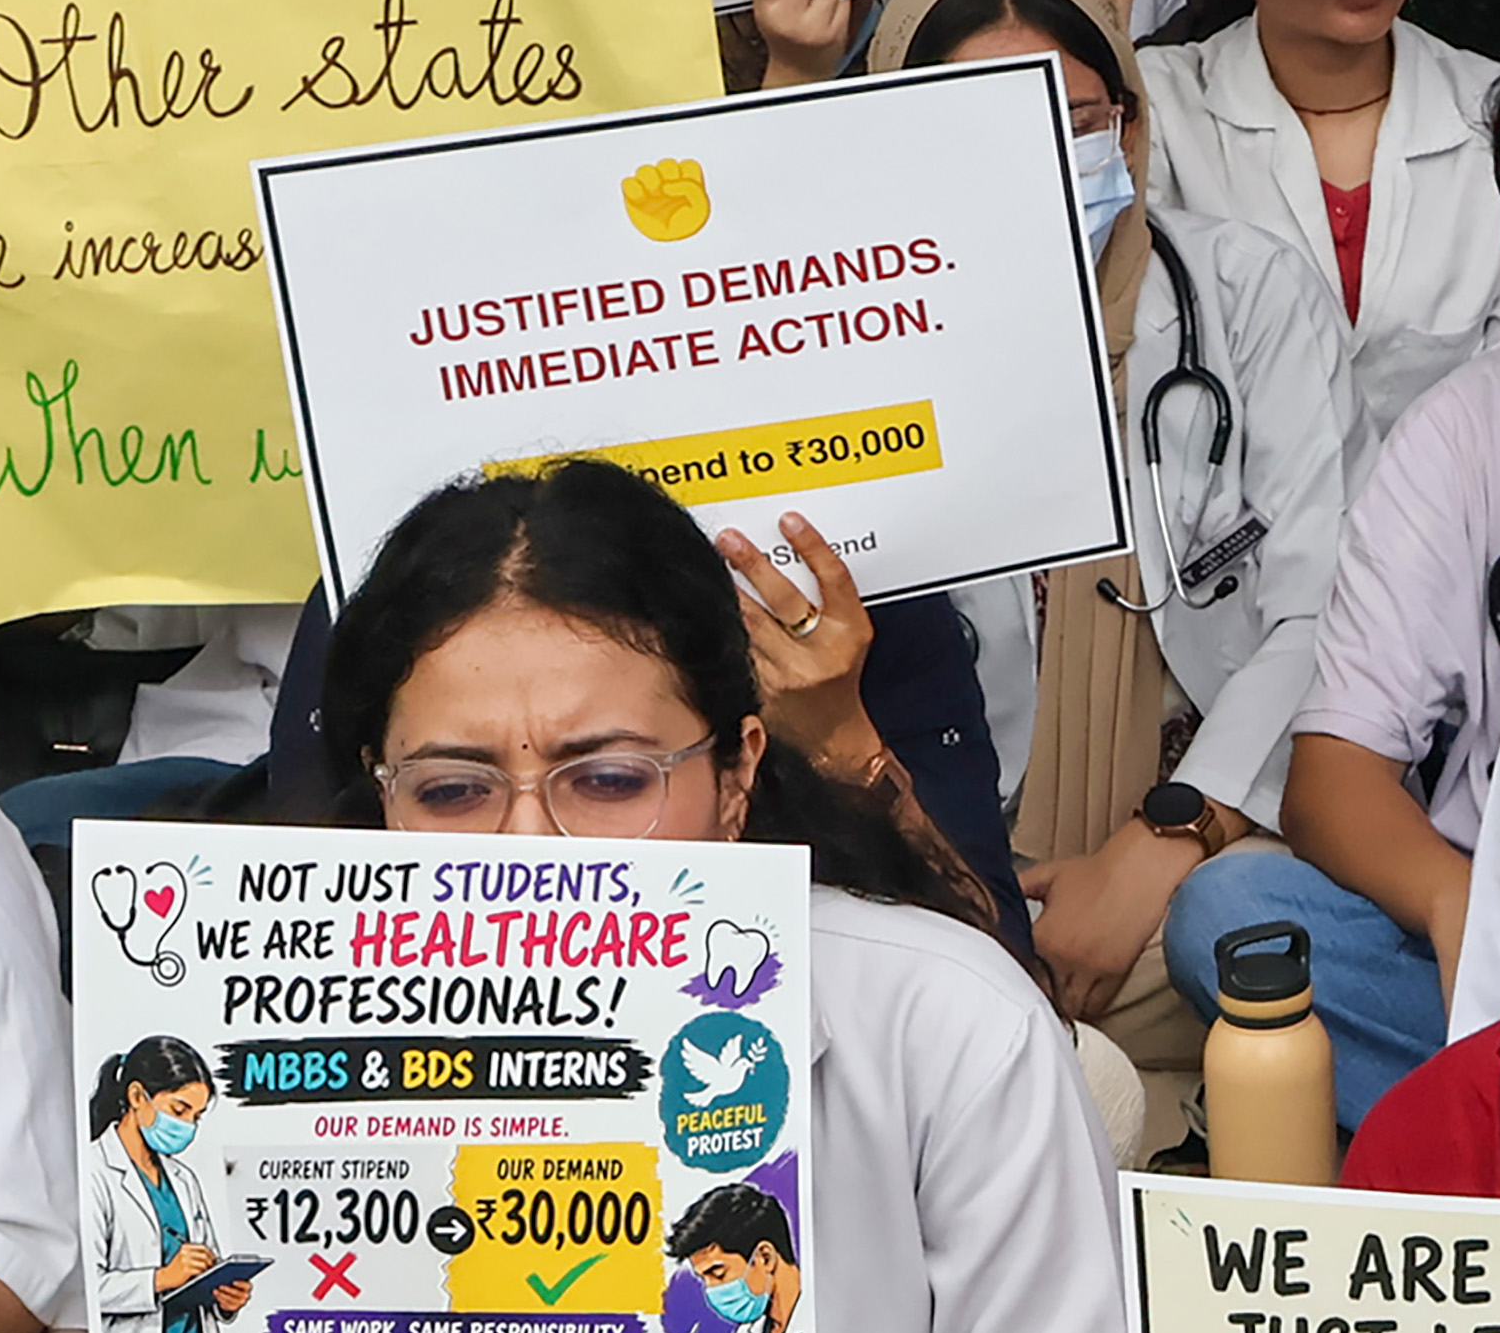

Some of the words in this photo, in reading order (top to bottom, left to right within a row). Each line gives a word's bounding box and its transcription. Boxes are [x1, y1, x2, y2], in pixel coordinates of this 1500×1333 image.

[54, 216, 264, 282] increas
[408, 275, 667, 347] JUSTIFIED
[682, 239, 957, 312] DEMANDS.
[438, 331, 722, 403] IMMEDIATE
[736, 298, 946, 367] ACTION.
[737, 449, 774, 475] to
[786, 422, 925, 468] ₹30,000
[237, 862, 318, 905] NOT
[324, 862, 422, 905] JUST
[432, 860, 642, 909] STUDENTS,
[195, 923, 255, 962] WE
[263, 919, 335, 960] ARE
[350, 909, 691, 970] HEALTHCARE
[222, 973, 626, 1030] PROFESSIONALS!
[243, 1053, 350, 1093] MBBS
[360, 1054, 391, 1091] &
[400, 1052, 475, 1090] BDS
[487, 1049, 629, 1089] INTERNS
[676, 1103, 767, 1135] PEACEFUL
[687, 1126, 763, 1155] PROTEST
[246, 1187, 419, 1248] ₹12,300
[475, 1189, 651, 1247] ₹30,000
[1204, 1224, 1319, 1299] WE
[1349, 1234, 1491, 1303] ARE
